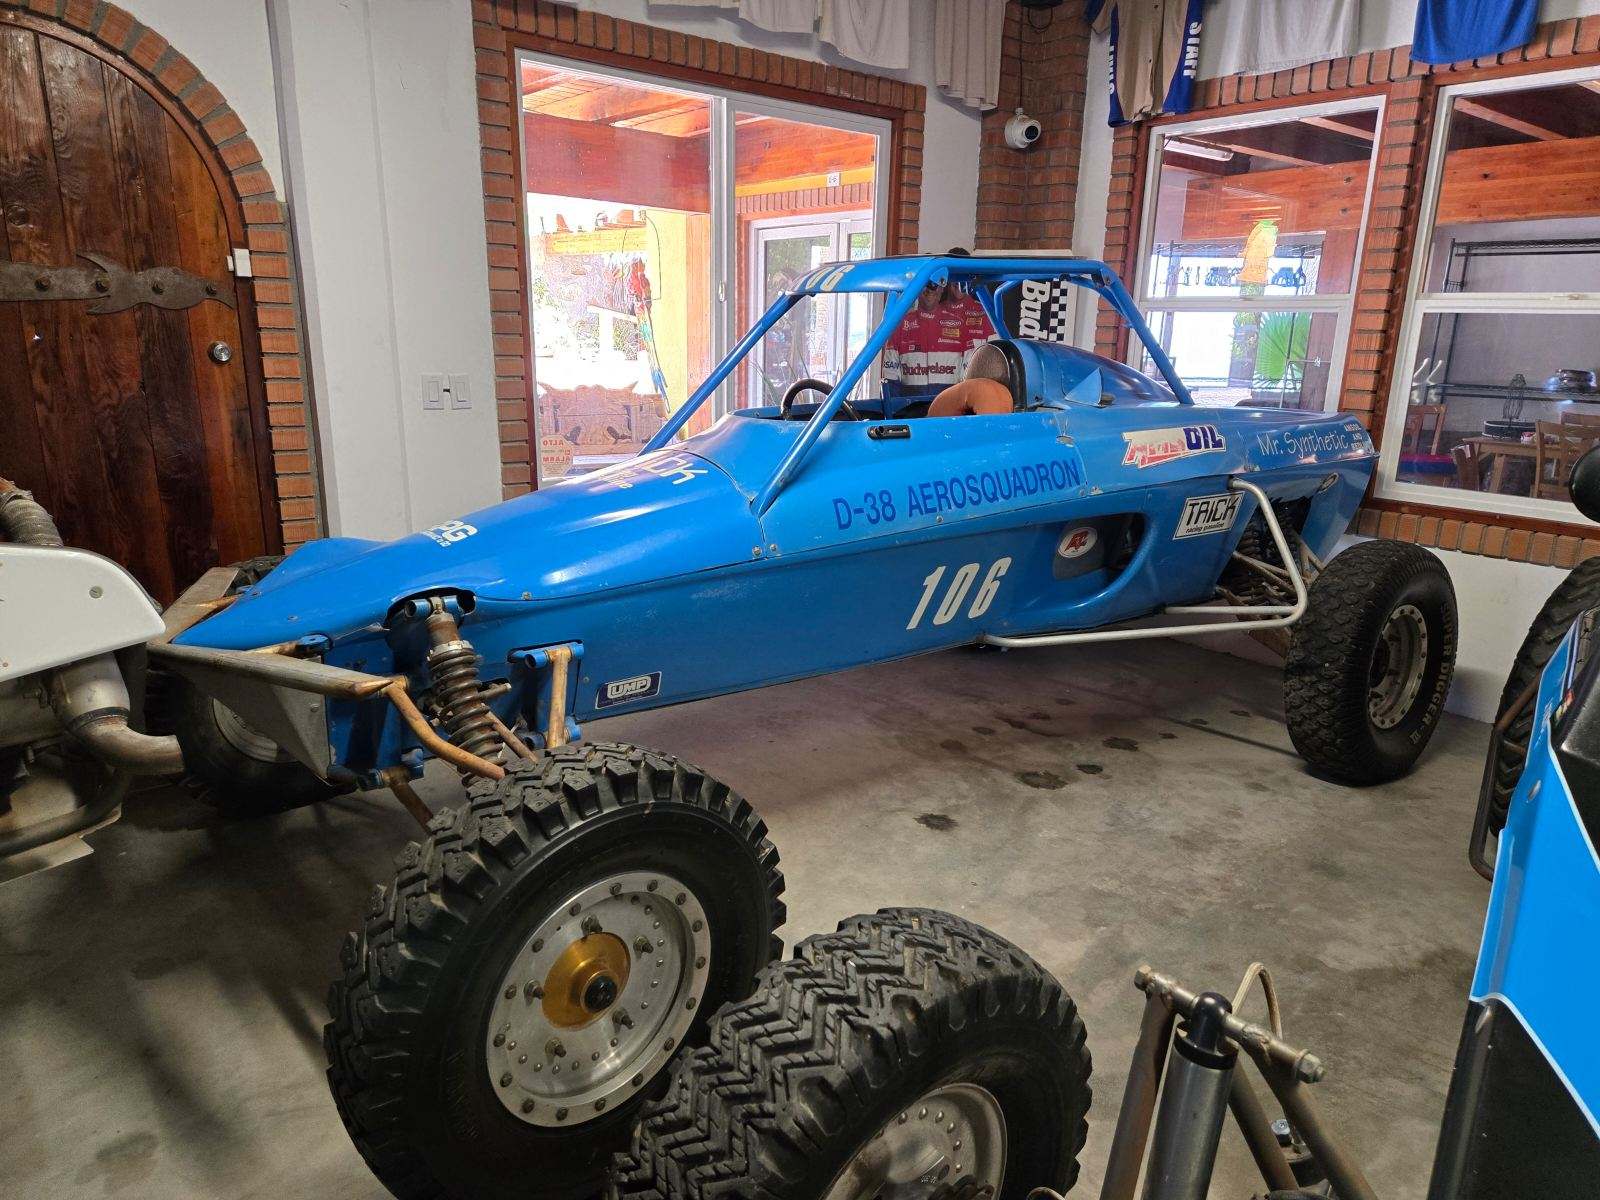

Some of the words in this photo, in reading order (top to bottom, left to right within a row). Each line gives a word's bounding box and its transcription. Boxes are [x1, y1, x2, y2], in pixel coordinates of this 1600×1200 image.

[1018, 279, 1051, 340] Bud
[901, 362, 956, 376] Budweiser
[1256, 433, 1284, 456] Mr.
[1284, 430, 1348, 459] Synthetic
[833, 491, 896, 530] D-38
[908, 458, 1080, 518] AEROSQUADRON
[1186, 495, 1239, 526] TRICK
[907, 557, 1013, 630] 106
[611, 678, 648, 696] UMP
[1422, 661, 1451, 725] DIGGER
